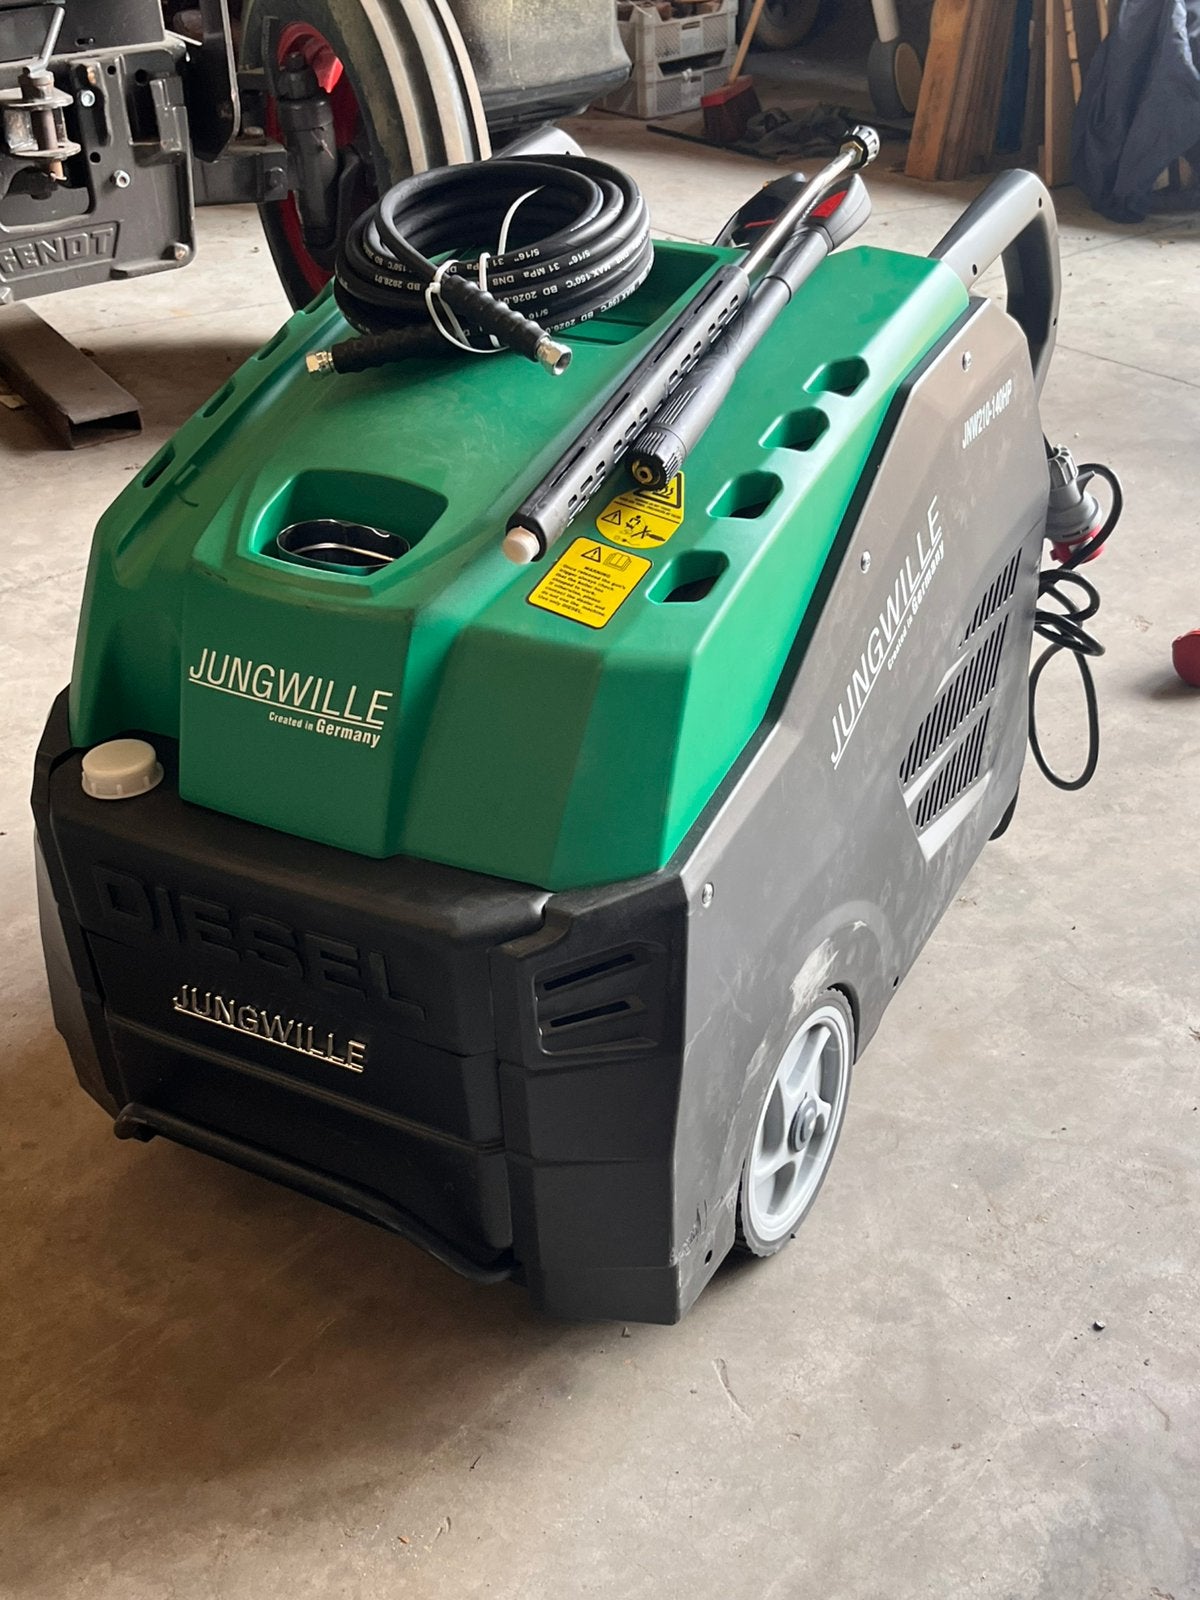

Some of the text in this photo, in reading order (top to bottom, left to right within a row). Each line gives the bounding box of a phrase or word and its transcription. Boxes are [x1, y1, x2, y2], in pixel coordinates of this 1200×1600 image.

[0, 228, 113, 272] FENDT
[523, 266, 545, 278] MPa
[548, 262, 560, 272] 31
[407, 281, 421, 291] BD
[542, 285, 558, 296] BD
[911, 539, 944, 615] Germany
[831, 495, 941, 764] JUNGWILLE
[189, 648, 393, 725] JUNGWILLE
[268, 711, 381, 748] Created in Germany
[93, 861, 426, 1021] DIESEL
[172, 984, 367, 1070] JUNGWILLE
